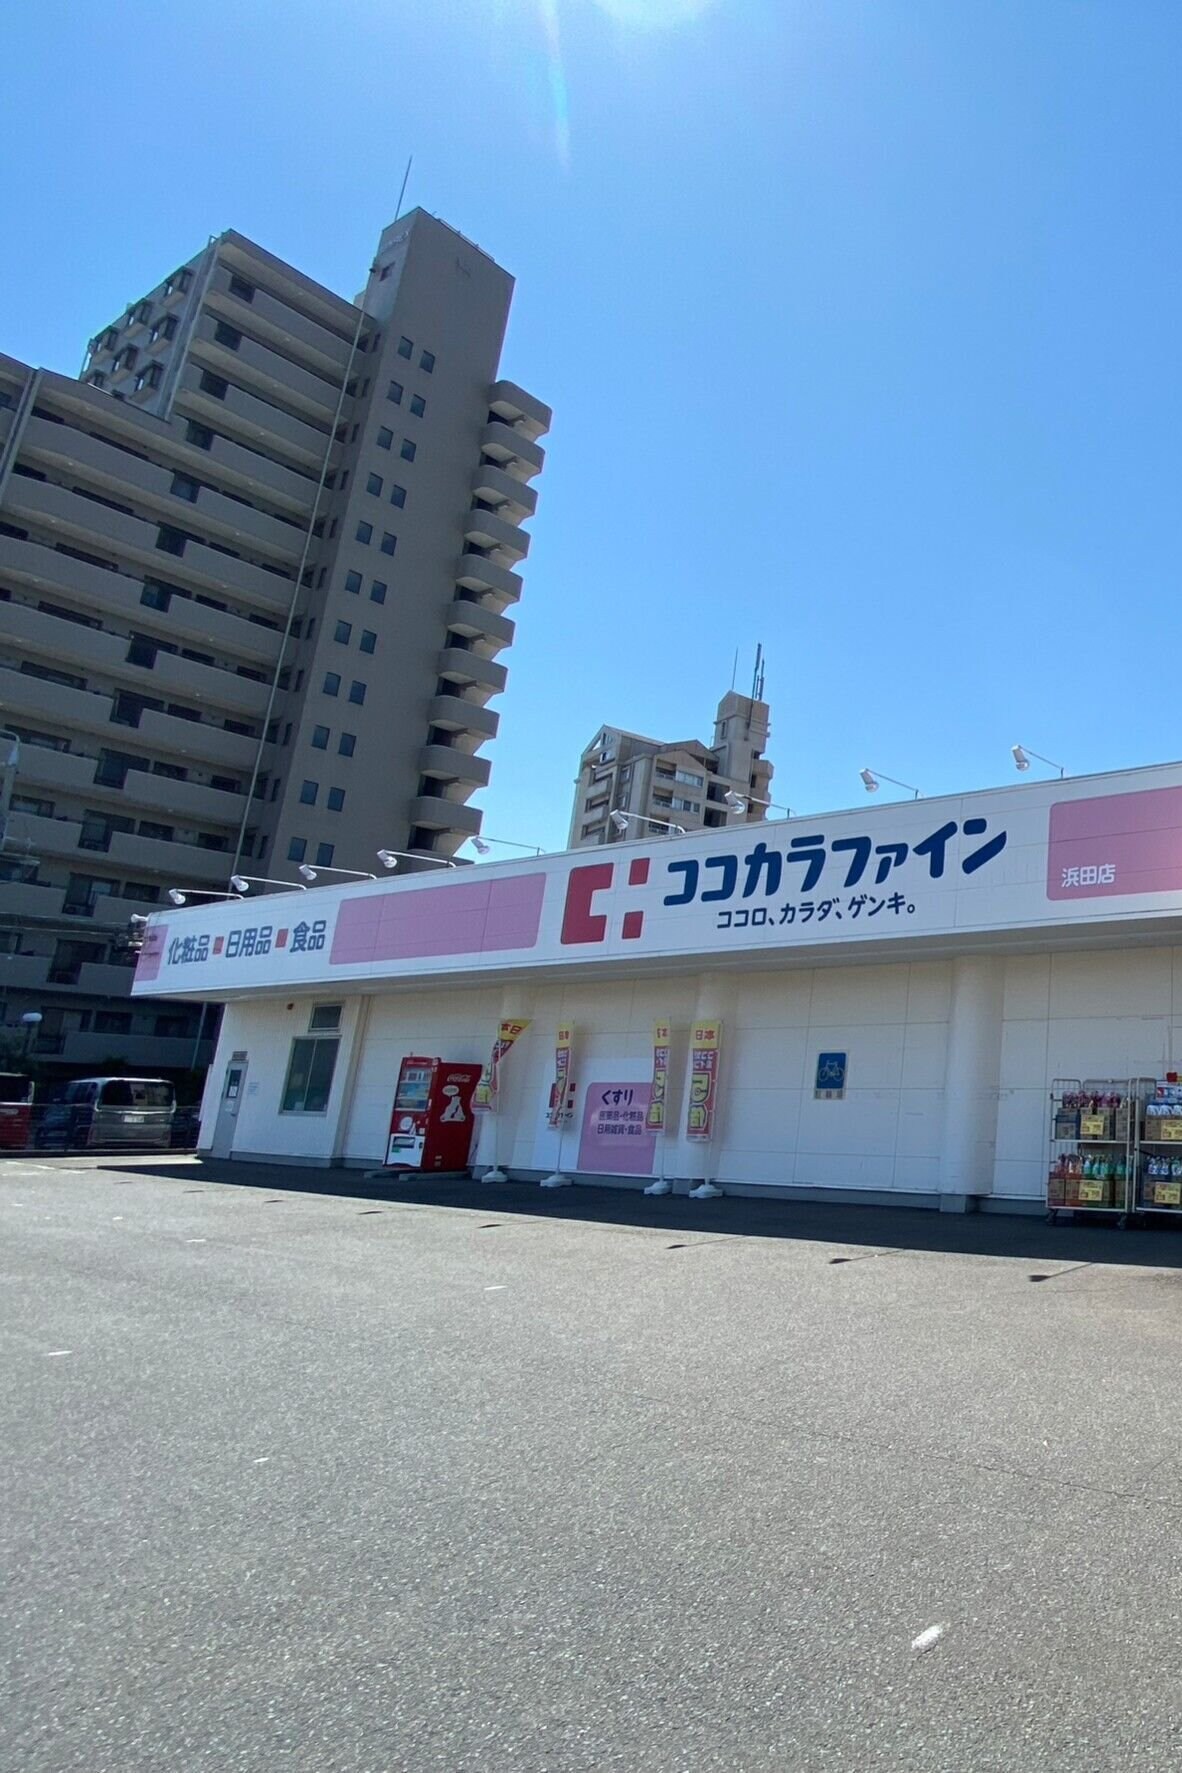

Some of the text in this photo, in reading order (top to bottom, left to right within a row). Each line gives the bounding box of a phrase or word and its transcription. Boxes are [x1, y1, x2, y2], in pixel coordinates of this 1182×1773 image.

[663, 818, 1008, 906] ココカラファイン
[1061, 863, 1116, 888] 浜田店
[716, 891, 915, 929] ココロ、カラダ、ゲンキ。
[168, 920, 327, 965] 化粧品 日用品 食品
[601, 1088, 633, 1106] くすり
